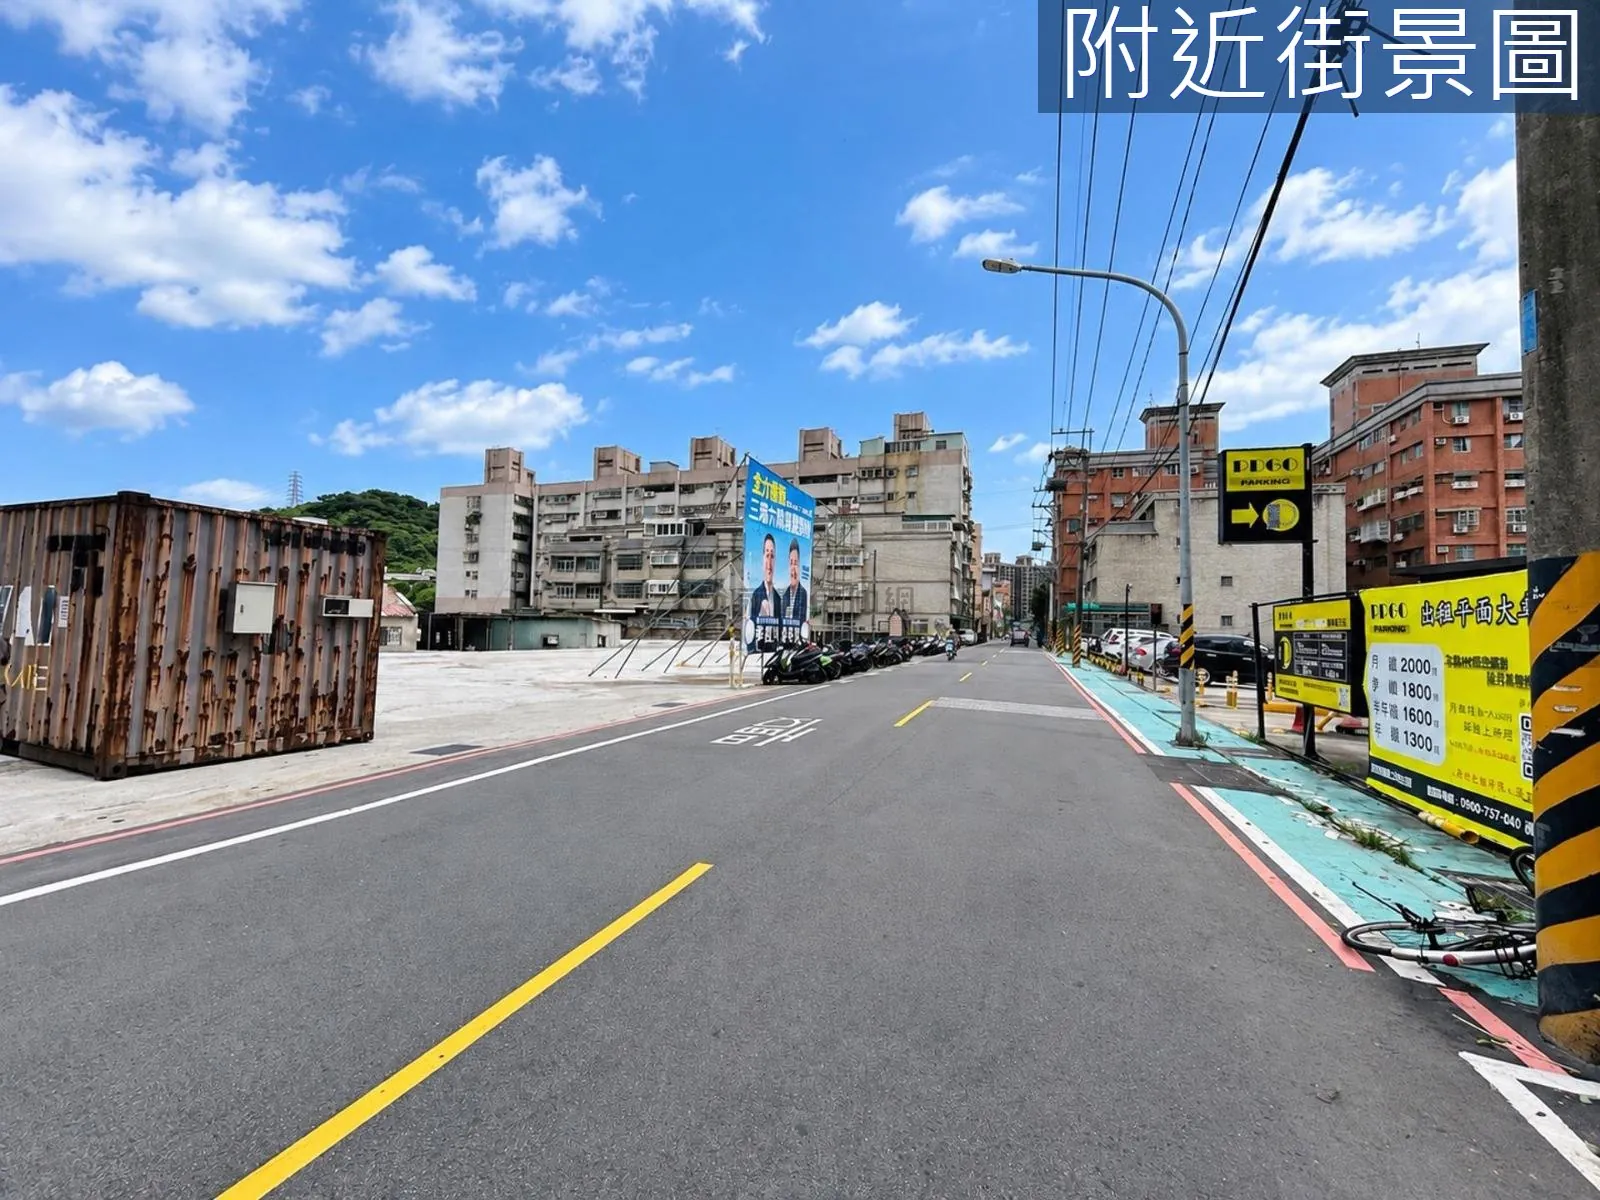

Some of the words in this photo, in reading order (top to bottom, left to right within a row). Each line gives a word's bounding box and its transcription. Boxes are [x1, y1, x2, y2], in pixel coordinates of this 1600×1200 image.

[1240, 478, 1291, 486] PARKING
[1401, 658, 1431, 675] 2000
[1402, 681, 1432, 701] 1800
[1403, 706, 1433, 727] 1600
[1404, 730, 1433, 752] 1300
[1460, 798, 1522, 830] 0900-757-040
